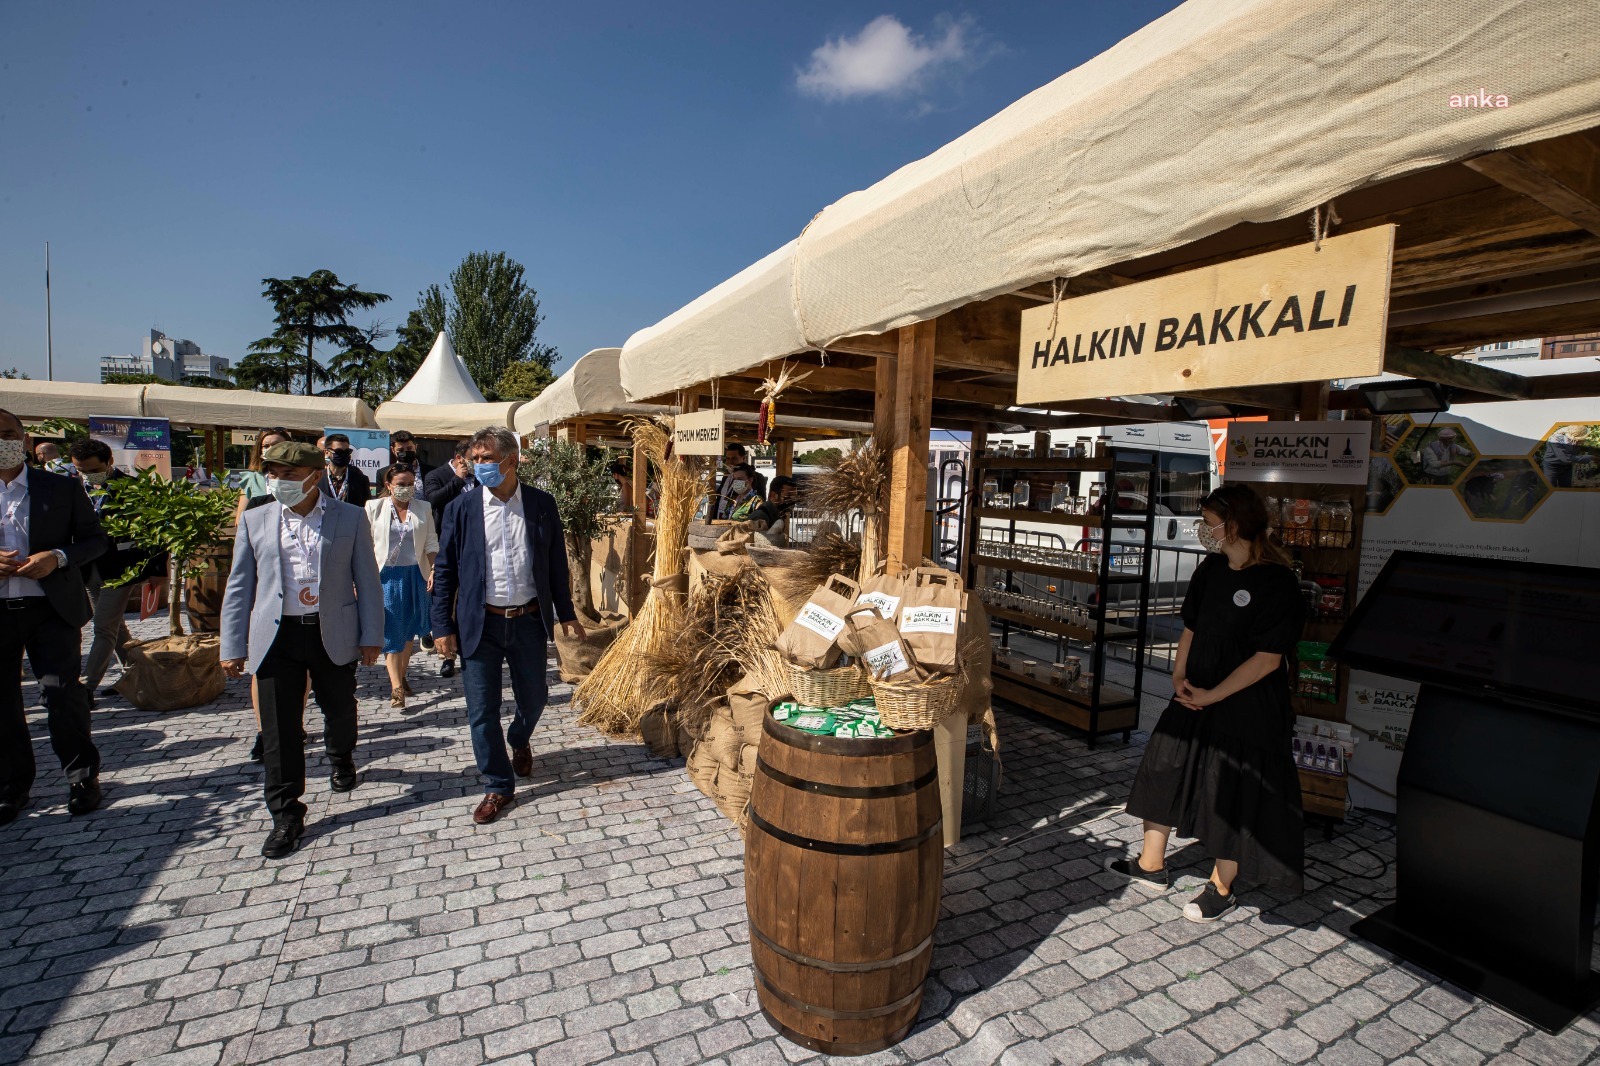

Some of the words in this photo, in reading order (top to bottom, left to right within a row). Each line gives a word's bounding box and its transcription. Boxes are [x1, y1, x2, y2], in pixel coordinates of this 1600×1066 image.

[1031, 322, 1147, 370] HALKIN
[1154, 284, 1357, 353] BAKKALI
[243, 434, 258, 442] TAR
[676, 429, 695, 442] TOHUM
[695, 424, 720, 442] MERKEZİ
[1254, 436, 1329, 448] HALKIN
[1253, 448, 1329, 459] BAKKALI
[350, 459, 380, 468] ARKEM
[807, 615, 830, 629] BAKKALI
[810, 610, 833, 626] HALKIN
[1374, 690, 1416, 703] HALK
[1373, 698, 1417, 709] BAKKA
